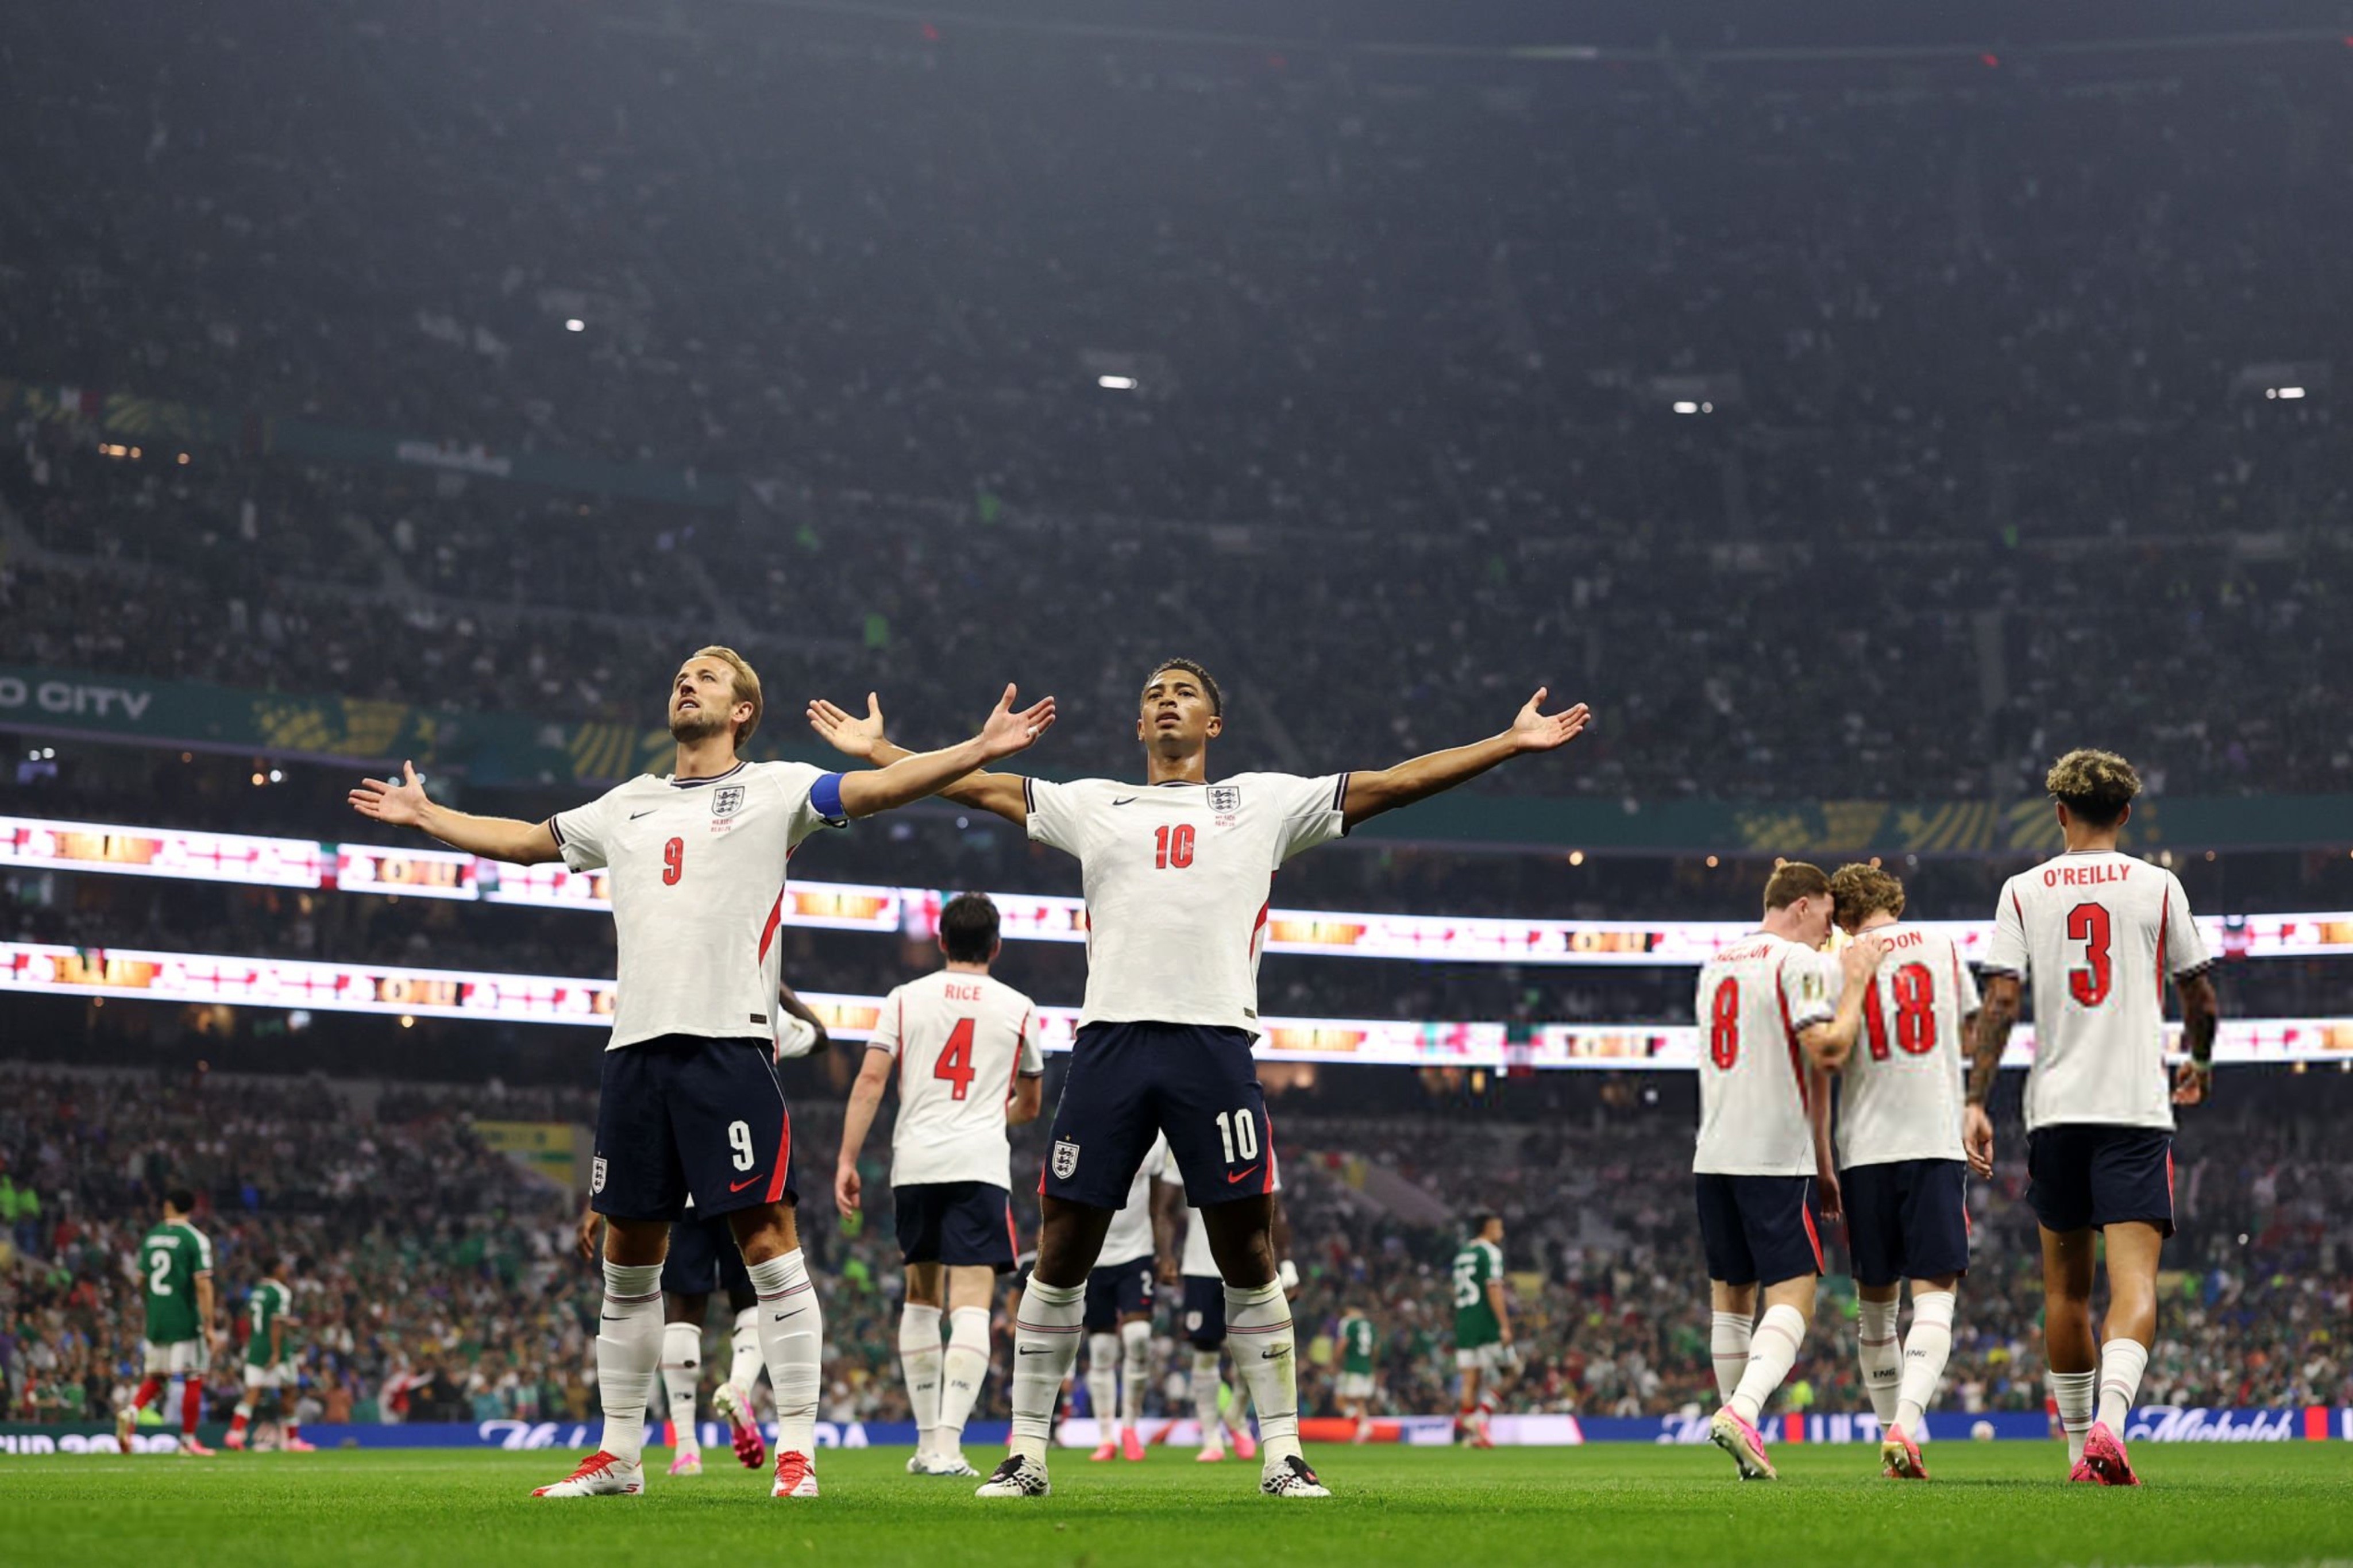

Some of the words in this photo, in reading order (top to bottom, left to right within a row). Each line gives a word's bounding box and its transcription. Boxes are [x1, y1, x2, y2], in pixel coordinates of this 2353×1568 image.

[38, 682, 151, 719] CITY
[663, 837, 684, 885] 9
[1155, 824, 1195, 869] 10
[2043, 863, 2131, 888] O'REILLY
[2067, 902, 2111, 1007] 3
[945, 984, 982, 1002] RICE
[1863, 961, 1937, 1061] 18
[1710, 976, 1739, 1071] 8
[934, 1018, 975, 1101] 4
[728, 1120, 754, 1172] 9
[1216, 1108, 1258, 1163] 10
[151, 1249, 172, 1296] 2
[1140, 1270, 1154, 1296] 2
